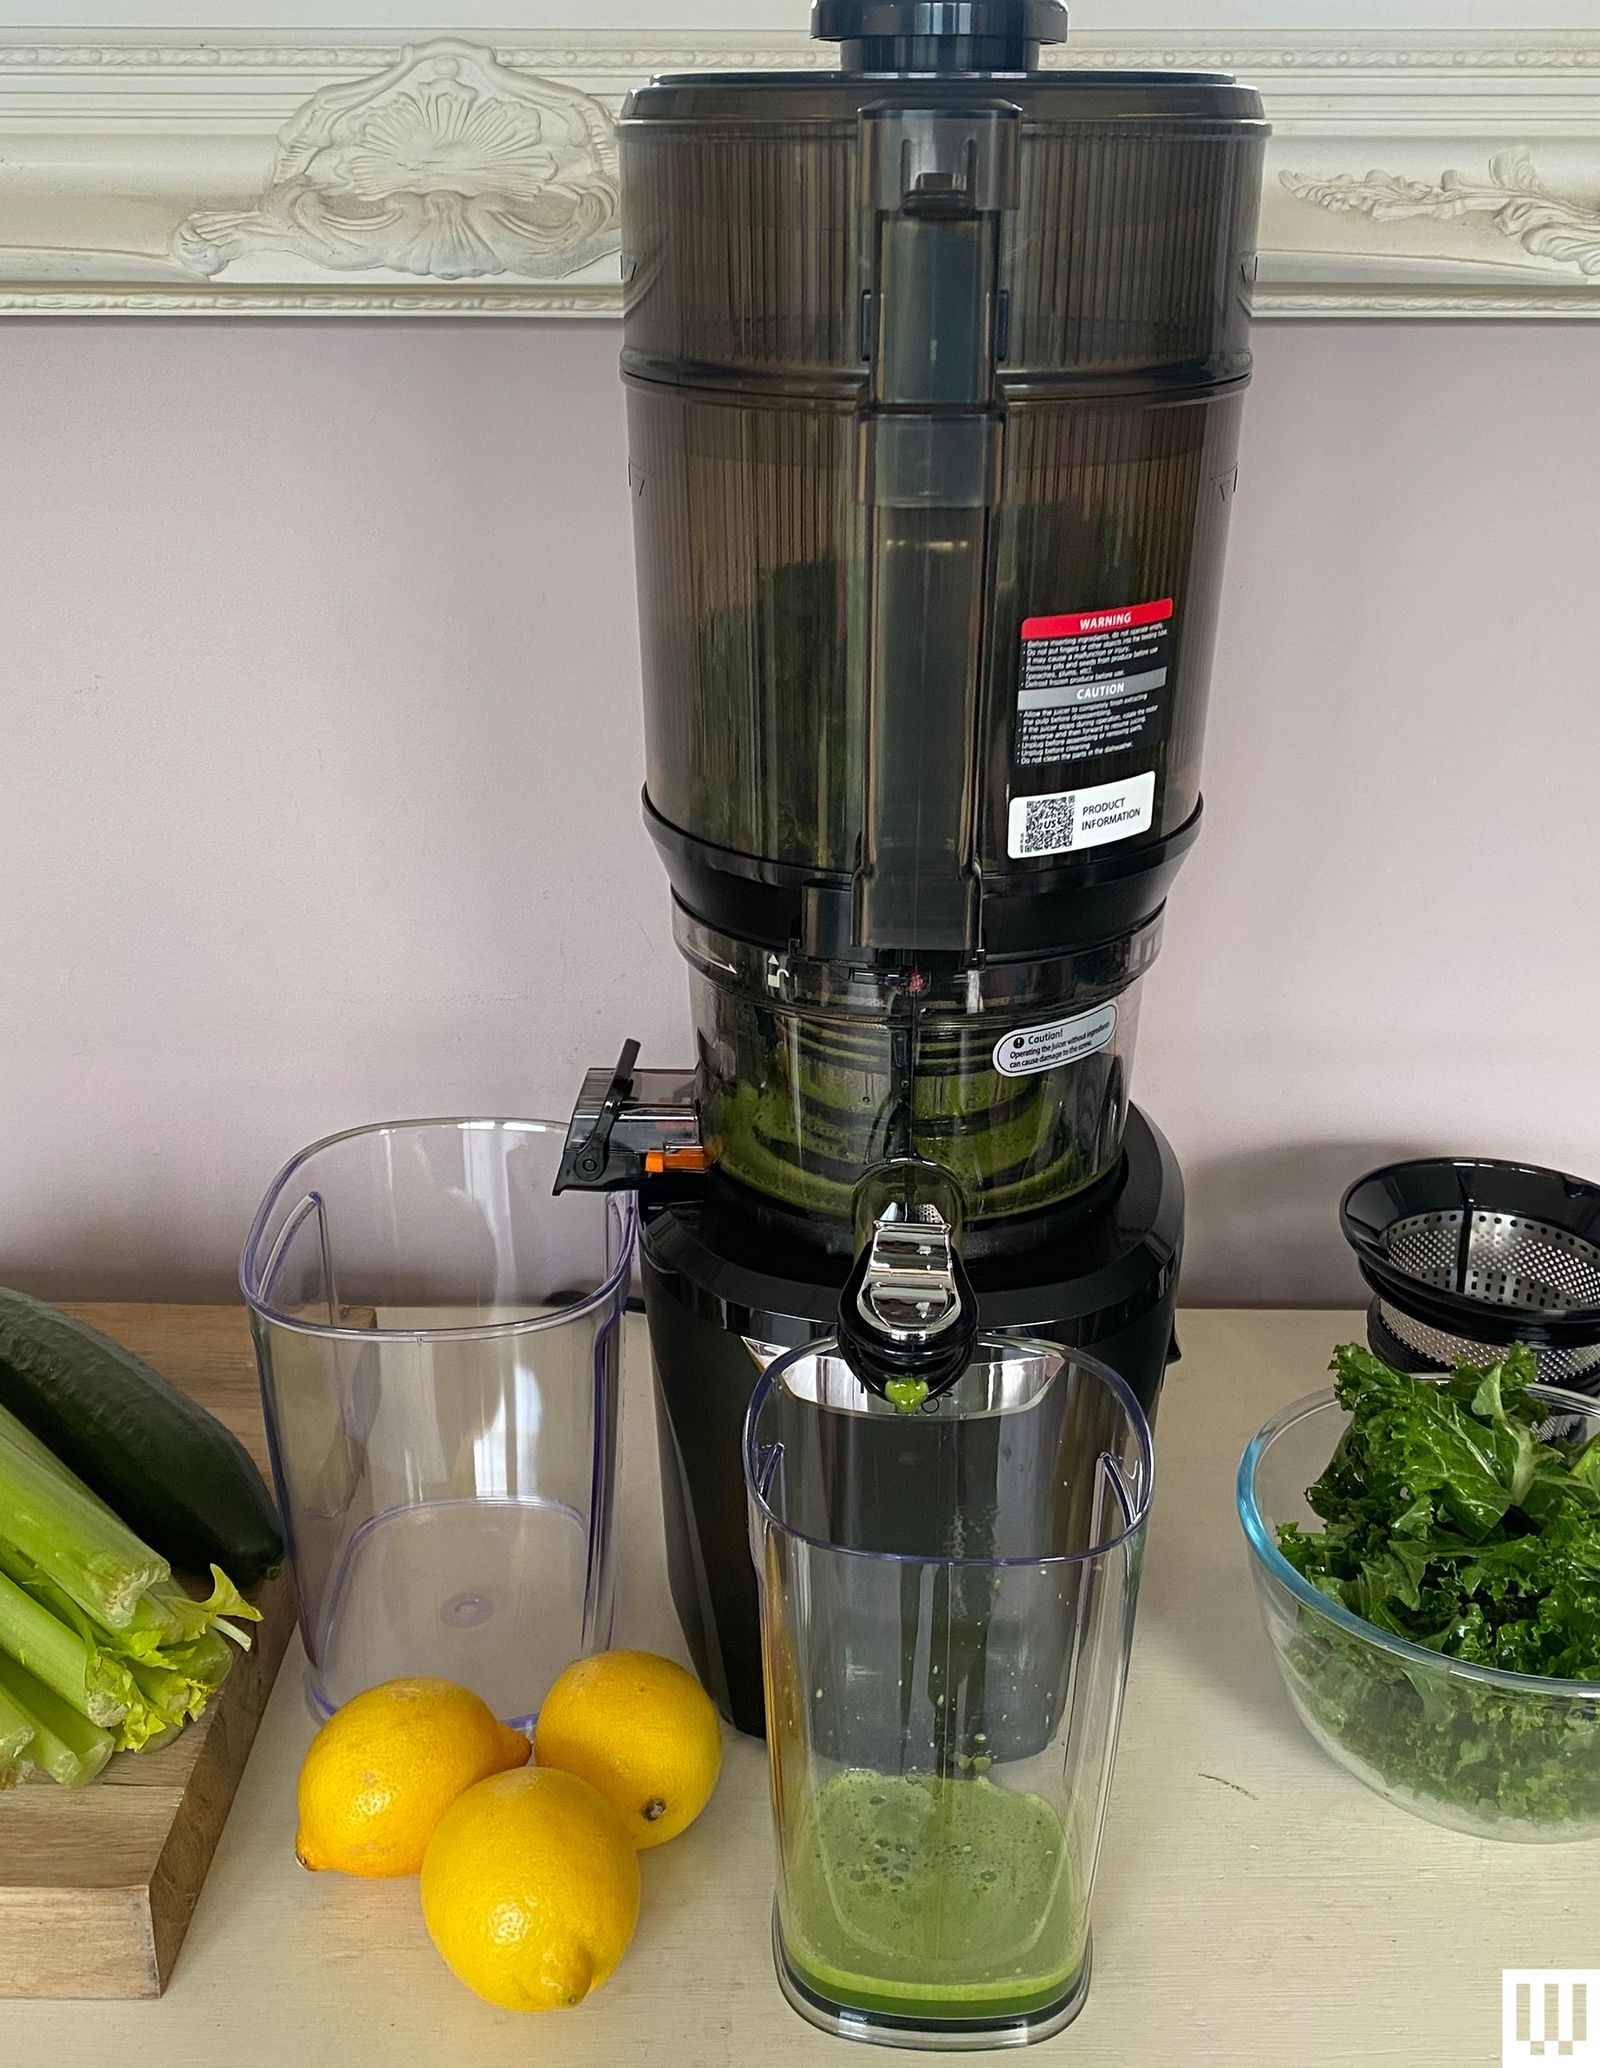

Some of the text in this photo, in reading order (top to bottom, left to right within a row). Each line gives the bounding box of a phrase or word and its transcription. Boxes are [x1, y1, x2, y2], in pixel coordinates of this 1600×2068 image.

[1080, 612, 1131, 630] WARNING
[1048, 647, 1058, 656] put
[1077, 683, 1124, 700] CAUTION
[1053, 708, 1070, 716] juicer
[1040, 725, 1057, 733] juicer
[1083, 797, 1126, 815] PRODUCT
[1082, 808, 1140, 830] INFORMATION
[1028, 1029, 1063, 1044] Caution!
[1010, 1048, 1040, 1059] Operating
[1068, 1033, 1086, 1044] without
[1040, 1052, 1062, 1062] damage
